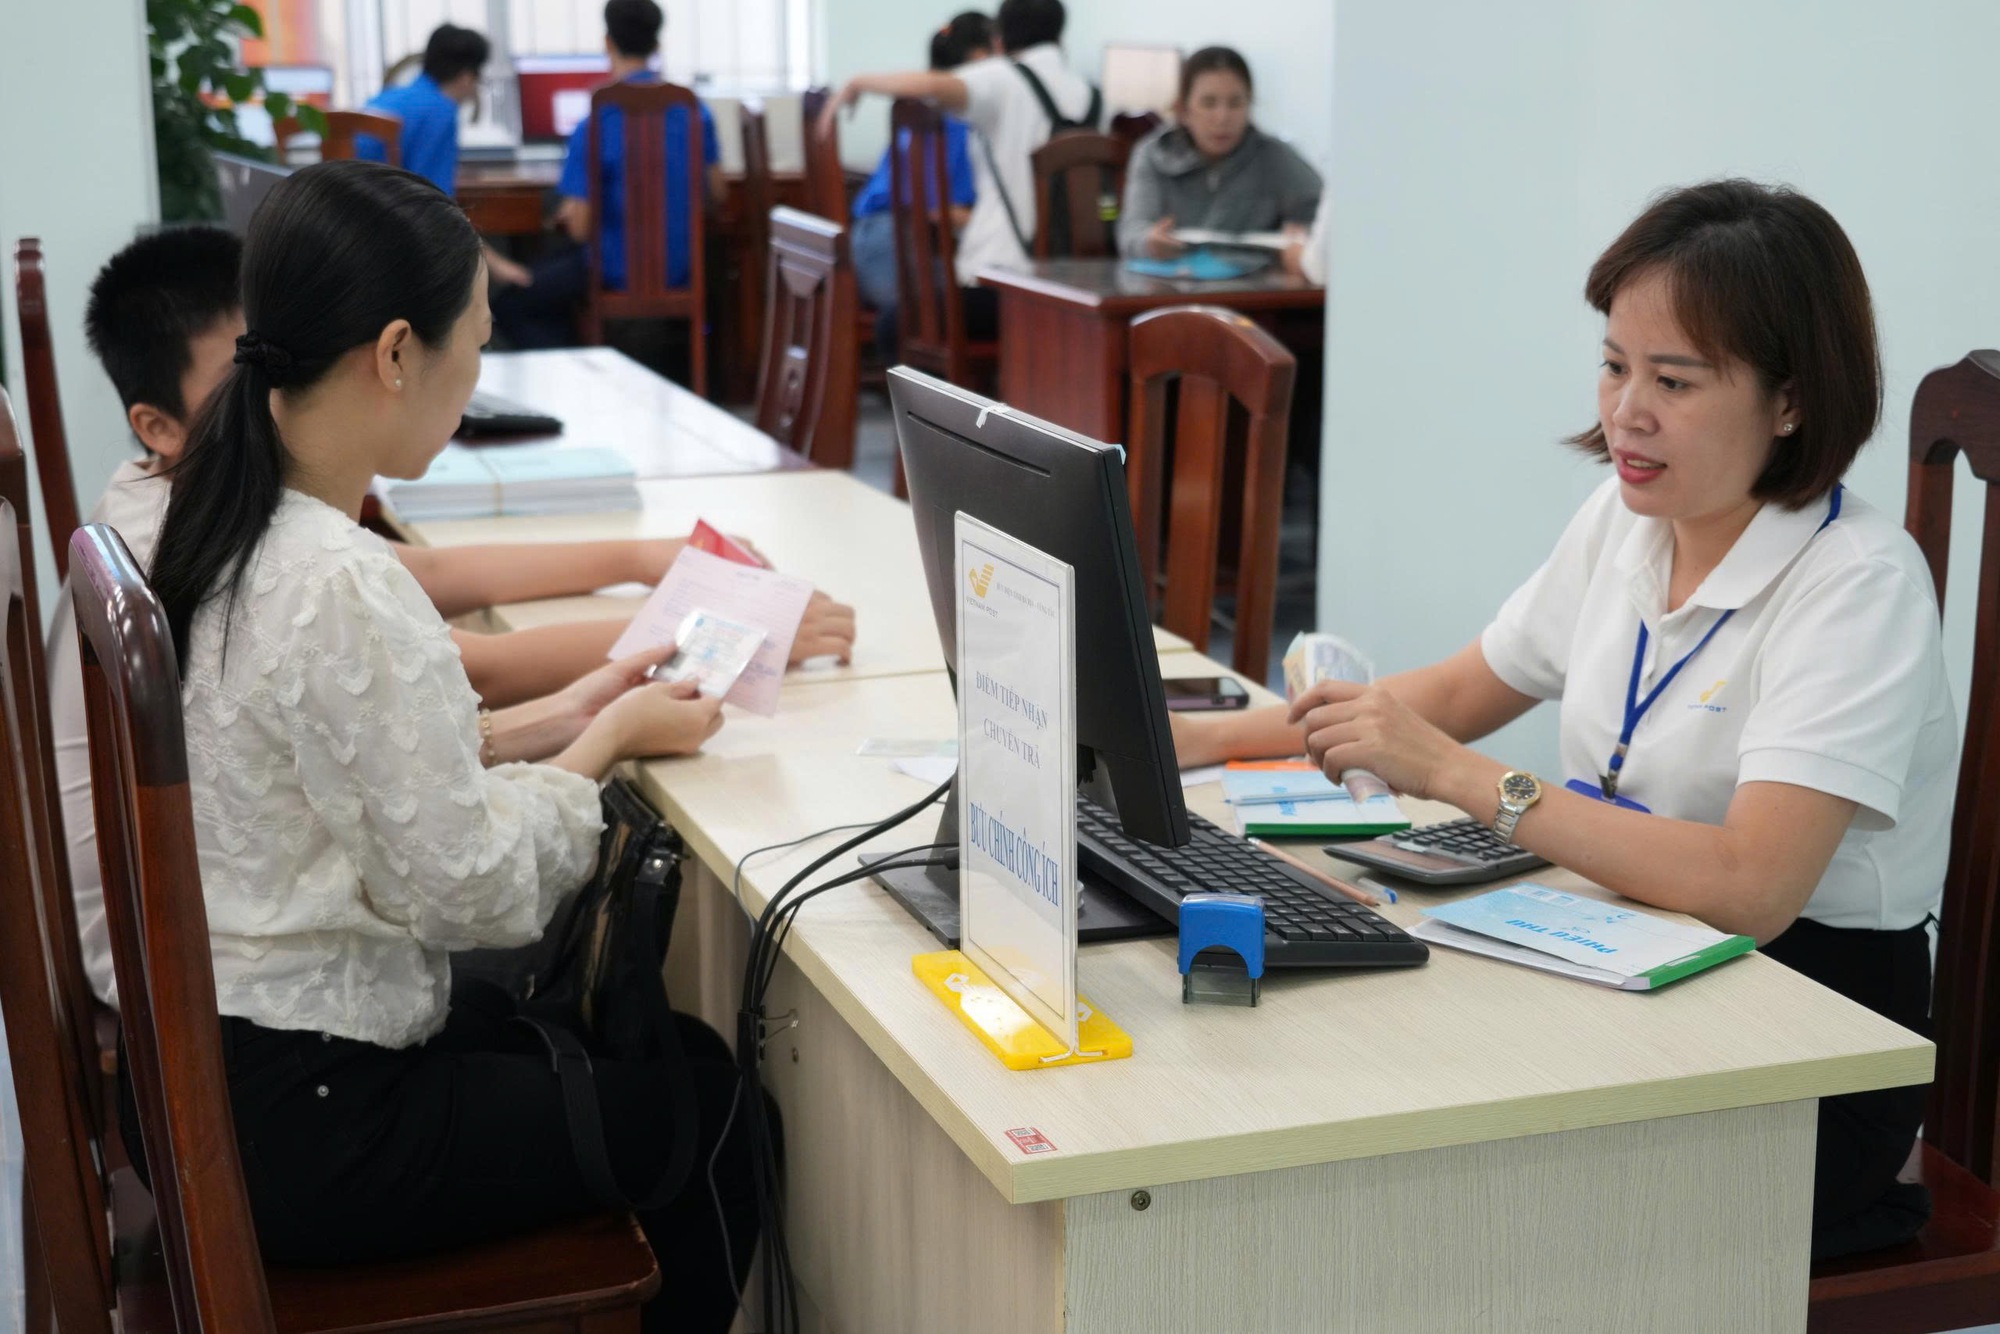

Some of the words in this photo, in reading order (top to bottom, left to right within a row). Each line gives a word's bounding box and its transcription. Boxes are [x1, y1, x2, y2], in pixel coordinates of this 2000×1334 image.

[970, 801, 987, 852] BƯU
[988, 810, 1015, 873] CHÍNH
[1016, 827, 1041, 893] CÔNG
[1041, 840, 1058, 907] ÍCH
[1504, 919, 1549, 934] THU
